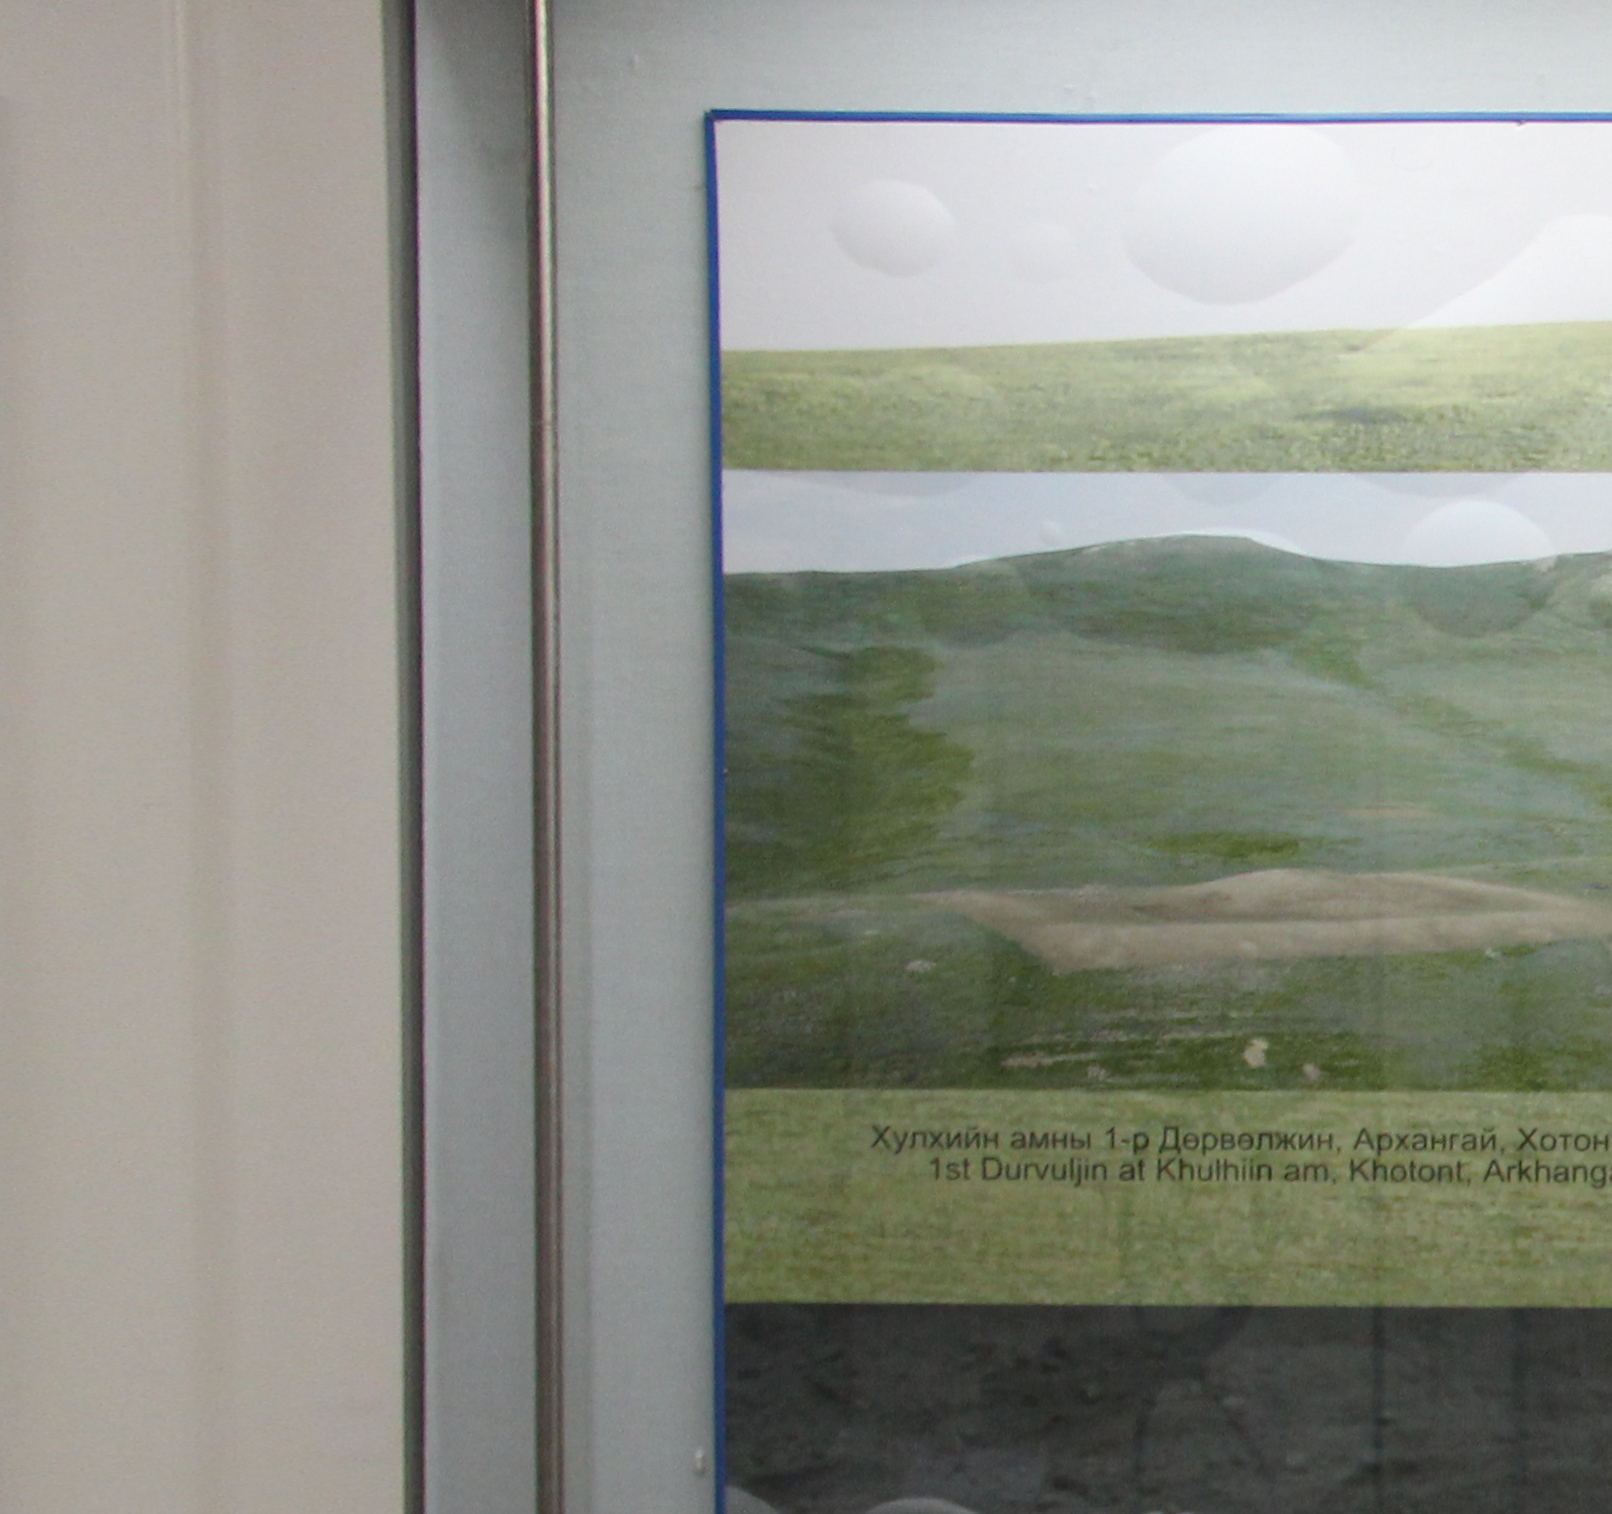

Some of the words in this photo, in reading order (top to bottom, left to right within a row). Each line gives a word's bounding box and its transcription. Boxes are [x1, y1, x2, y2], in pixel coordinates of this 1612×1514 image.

[1010, 1131, 1091, 1152] амны
[1105, 1125, 1149, 1158] 1-р
[1159, 1125, 1343, 1158] Дөрвөлжин,
[1354, 1126, 1506, 1158] Архангай,
[930, 1158, 972, 1184] 1st
[981, 1158, 1108, 1189] Durvuljin
[1117, 1158, 1146, 1184] at
[1281, 1164, 1338, 1187] am,
[1349, 1159, 1472, 1188] Khotont,
